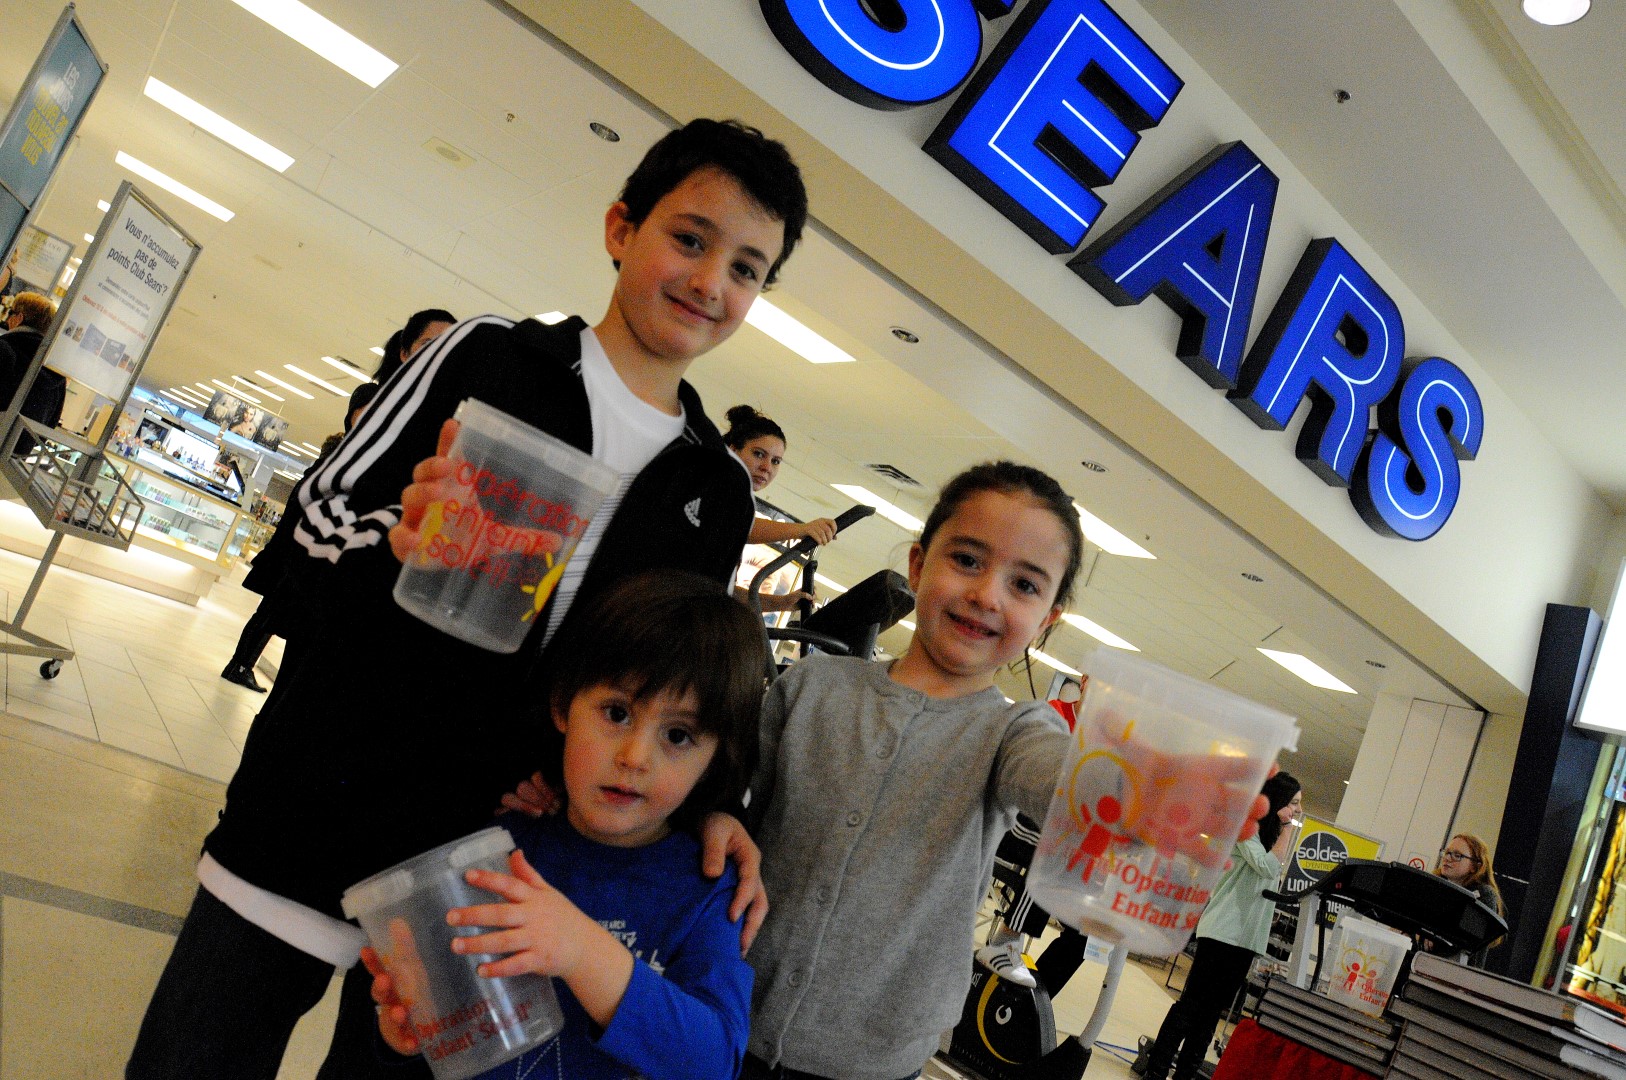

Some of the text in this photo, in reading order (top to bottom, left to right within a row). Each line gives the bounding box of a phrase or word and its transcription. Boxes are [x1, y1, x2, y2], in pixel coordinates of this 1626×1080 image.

[125, 217, 180, 270] Vous n'accumulez
[134, 248, 158, 271] pas de
[107, 247, 131, 270] points
[130, 261, 146, 281] Club
[1298, 832, 1347, 863] soldes
[1111, 891, 1180, 929] Enfant
